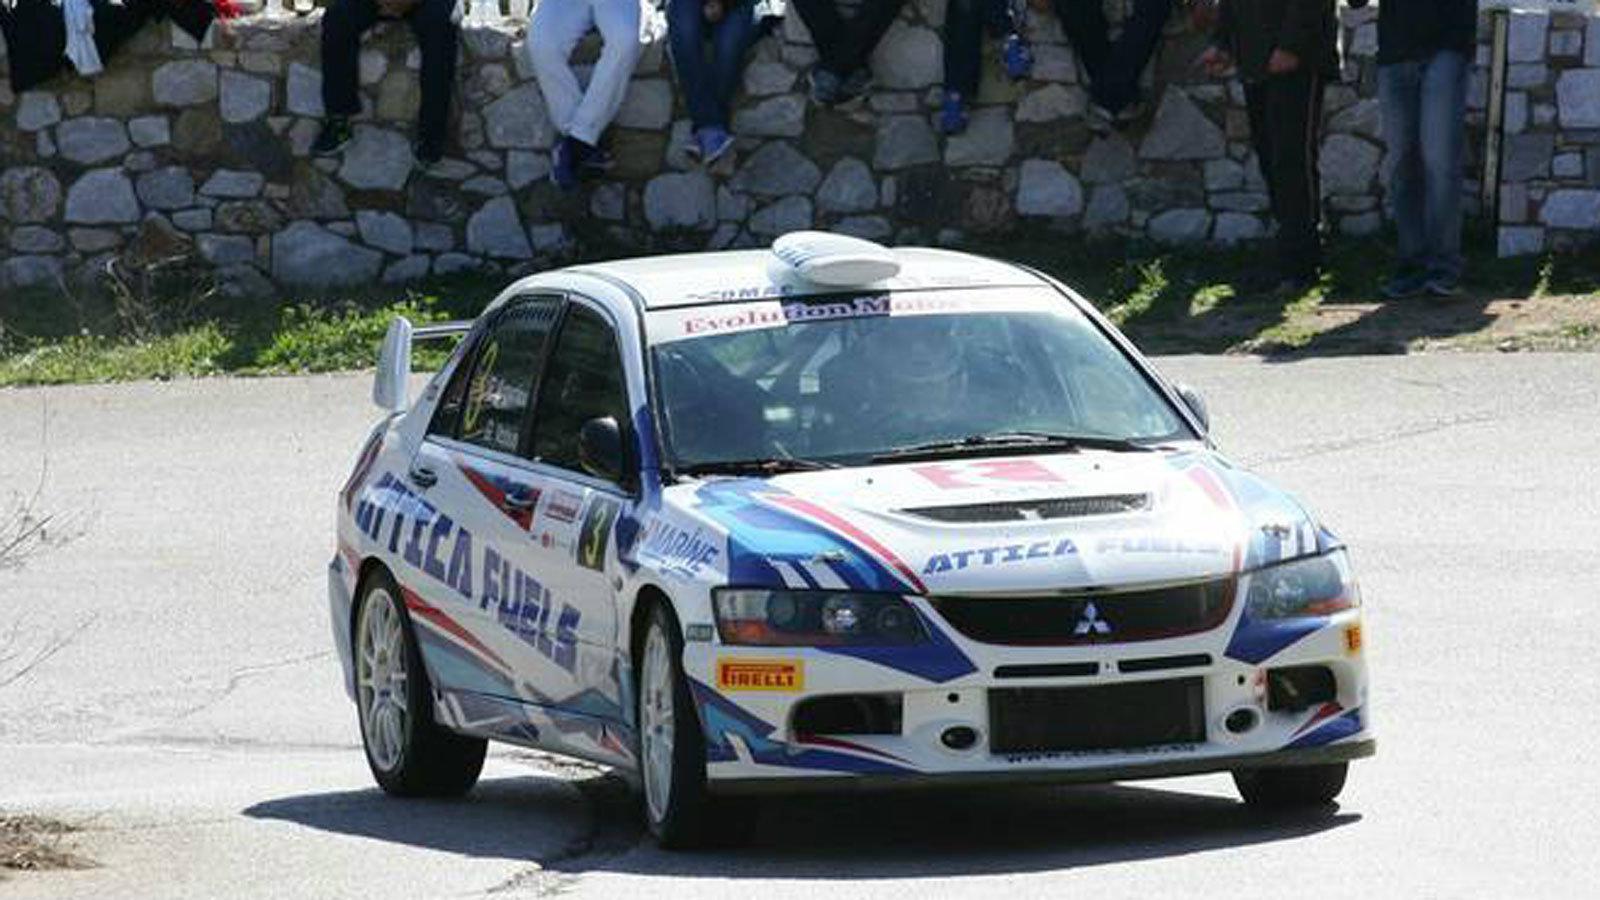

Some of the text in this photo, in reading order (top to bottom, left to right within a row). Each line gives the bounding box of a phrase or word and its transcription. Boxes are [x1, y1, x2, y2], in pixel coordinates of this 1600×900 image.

[922, 538, 1079, 575] ATTICA
[479, 545, 582, 676] FUELS
[720, 663, 797, 688] PIRELLI
